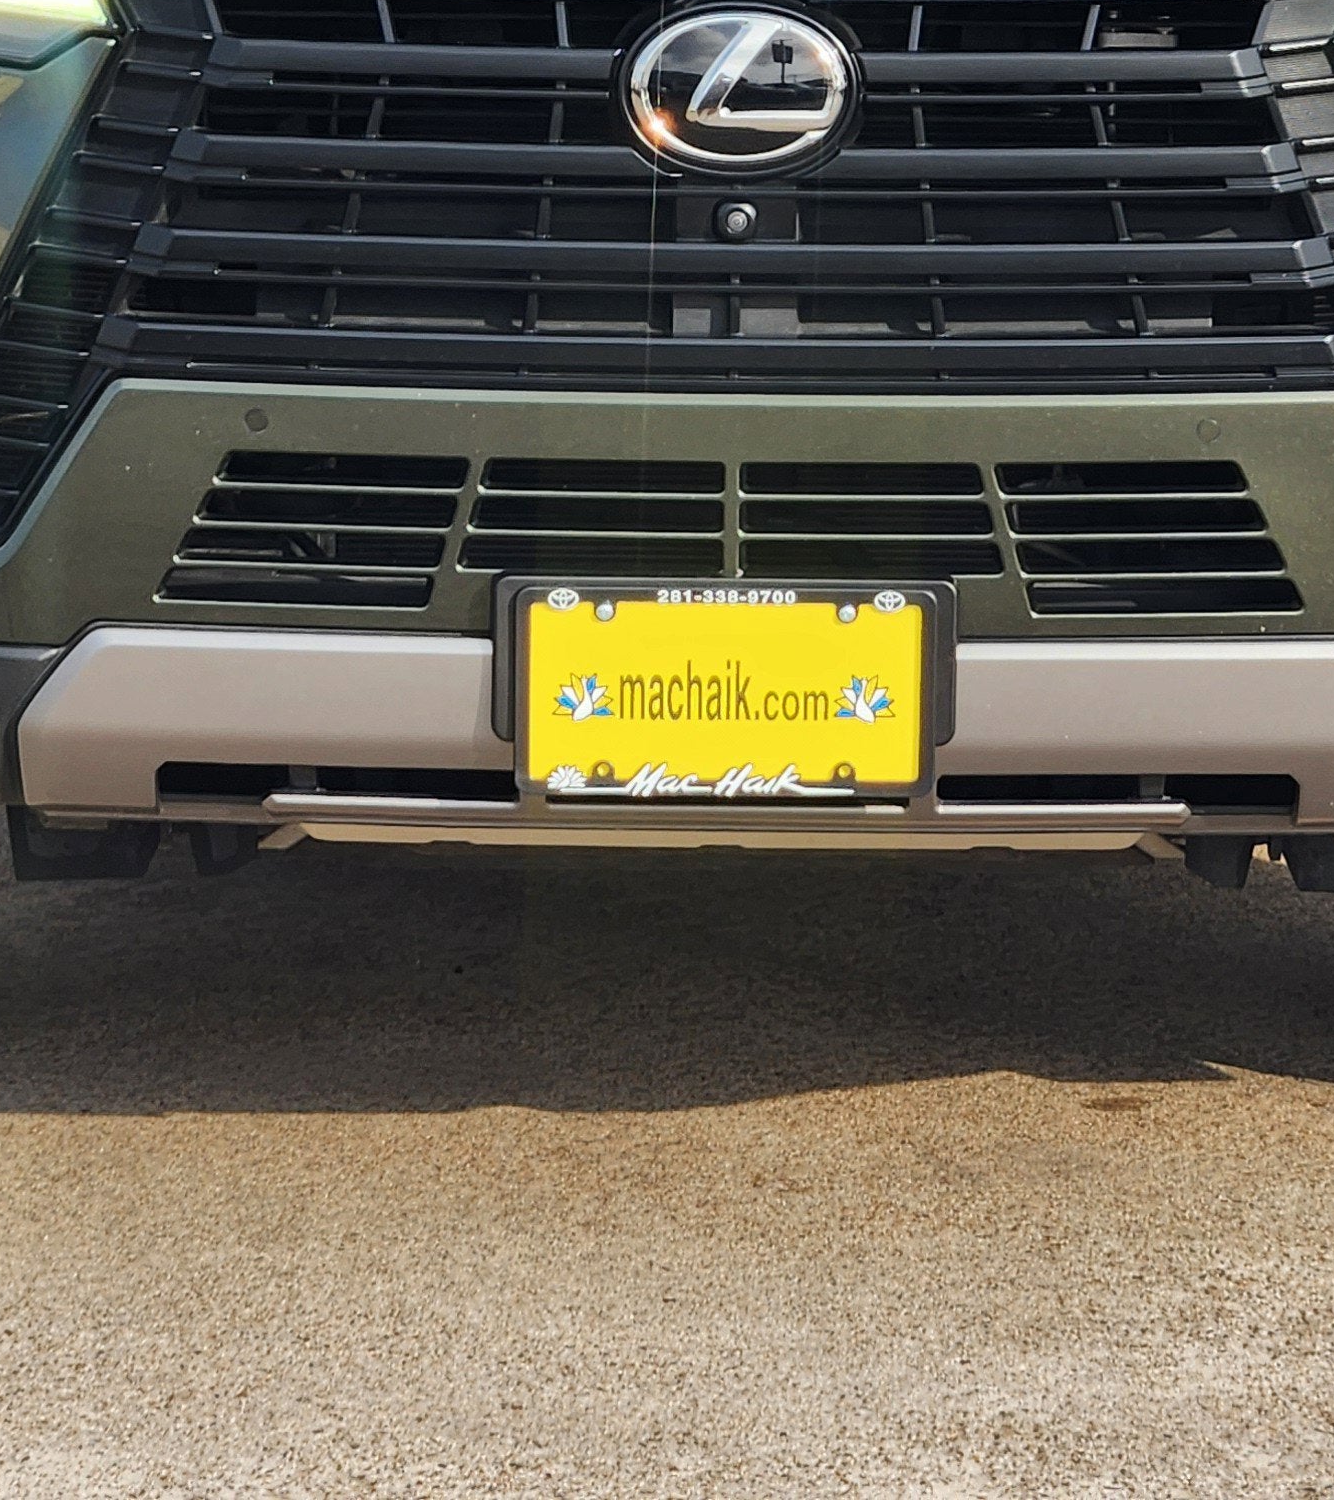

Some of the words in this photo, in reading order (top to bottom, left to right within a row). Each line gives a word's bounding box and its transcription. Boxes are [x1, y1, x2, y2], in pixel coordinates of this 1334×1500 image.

[657, 589, 797, 605] 281-338-9700
[619, 659, 830, 721] machaik.com
[622, 761, 712, 798] Mac
[713, 761, 809, 798] Haik
